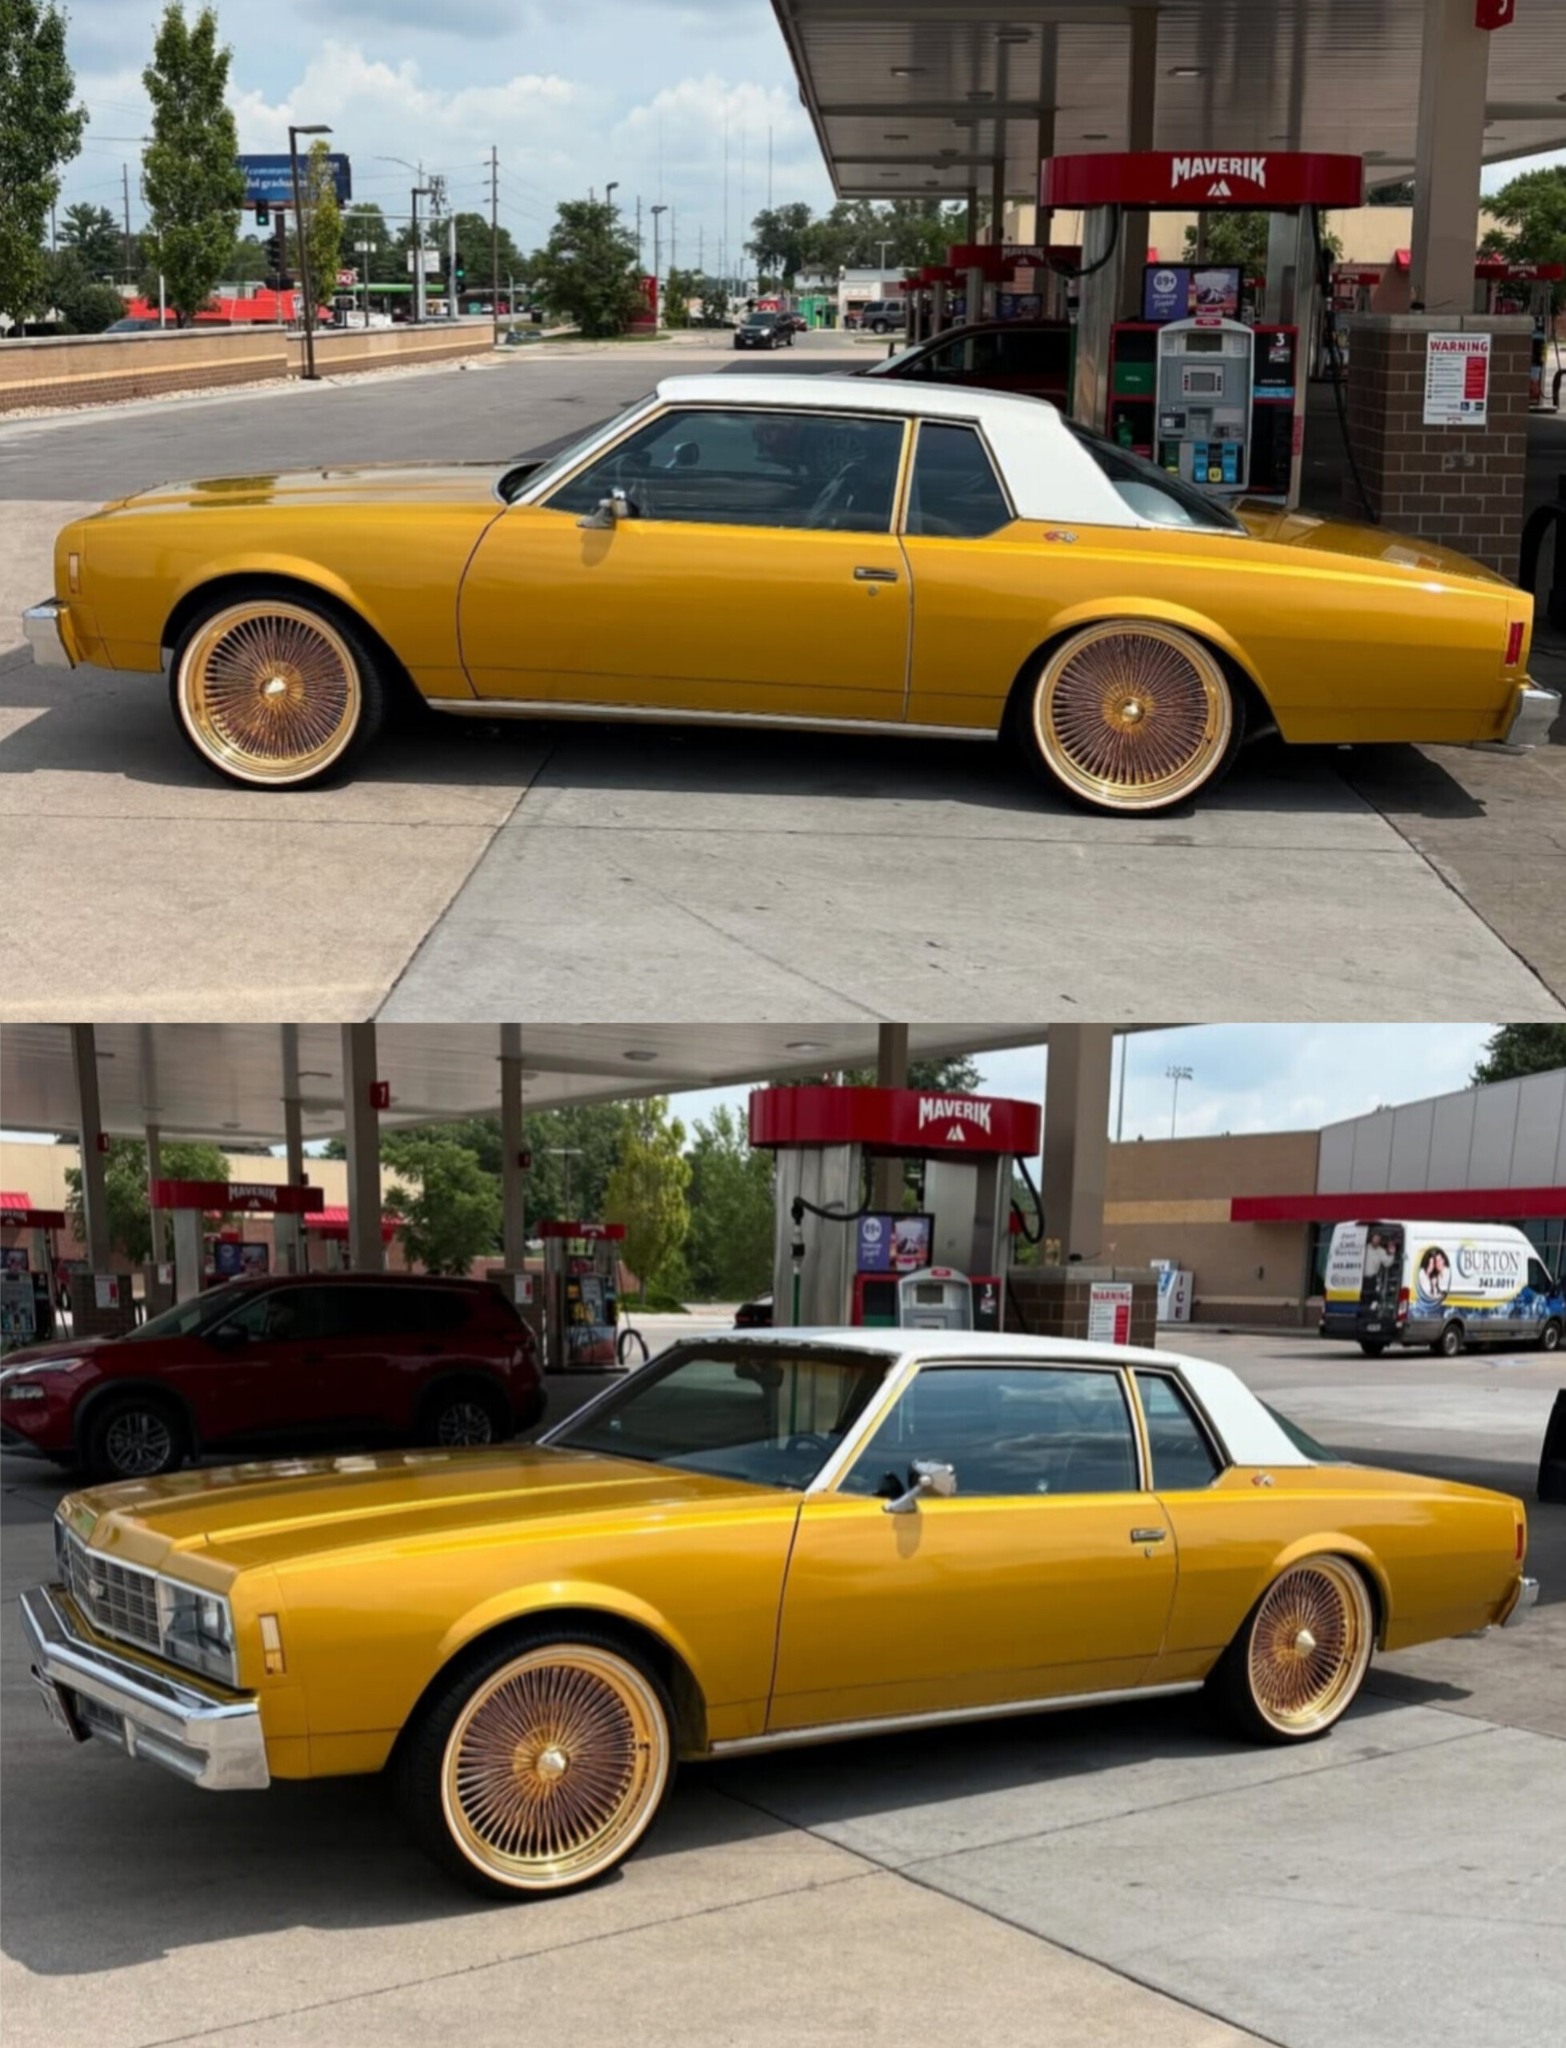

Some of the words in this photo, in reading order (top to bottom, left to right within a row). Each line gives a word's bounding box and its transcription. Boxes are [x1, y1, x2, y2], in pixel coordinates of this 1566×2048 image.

[1170, 156, 1267, 189] MAVERIK
[1275, 332, 1286, 347] 3
[1430, 341, 1489, 353] WARNING
[918, 1096, 992, 1135] MAVERIK
[229, 1185, 277, 1204] MAVERIK
[1464, 1250, 1519, 1271] BURTON
[1479, 1277, 1516, 1289] 343.0011
[1092, 1290, 1131, 1301] WARNING
